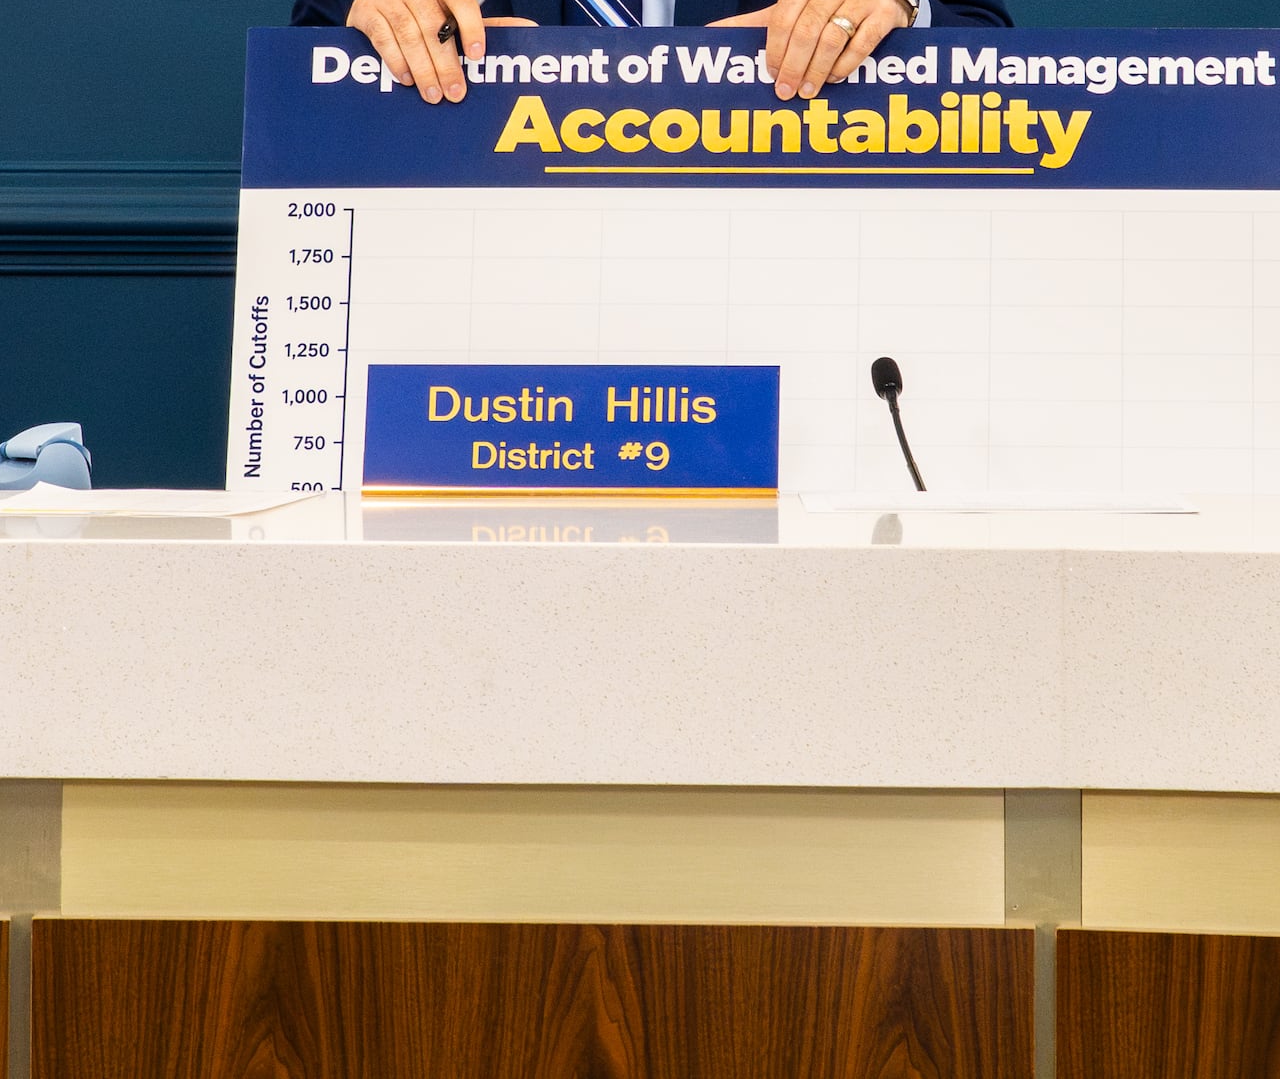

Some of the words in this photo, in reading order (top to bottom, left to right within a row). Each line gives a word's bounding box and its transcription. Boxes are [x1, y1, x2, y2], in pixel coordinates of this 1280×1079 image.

[617, 45, 669, 84] of
[951, 47, 1276, 94] Management
[493, 91, 1092, 169] Accountability
[287, 203, 336, 219] 2,000
[288, 249, 334, 265] 1,750
[285, 296, 332, 312] 1,500
[249, 295, 269, 369] Cutoffs
[284, 343, 330, 359] 1,250
[248, 373, 266, 394] of
[281, 390, 328, 405] 1,000
[427, 386, 573, 423] Dustin
[606, 386, 717, 424] Hillis
[244, 398, 265, 478] Number
[293, 436, 326, 450] 750
[471, 442, 595, 470] District
[617, 441, 671, 471] #9
